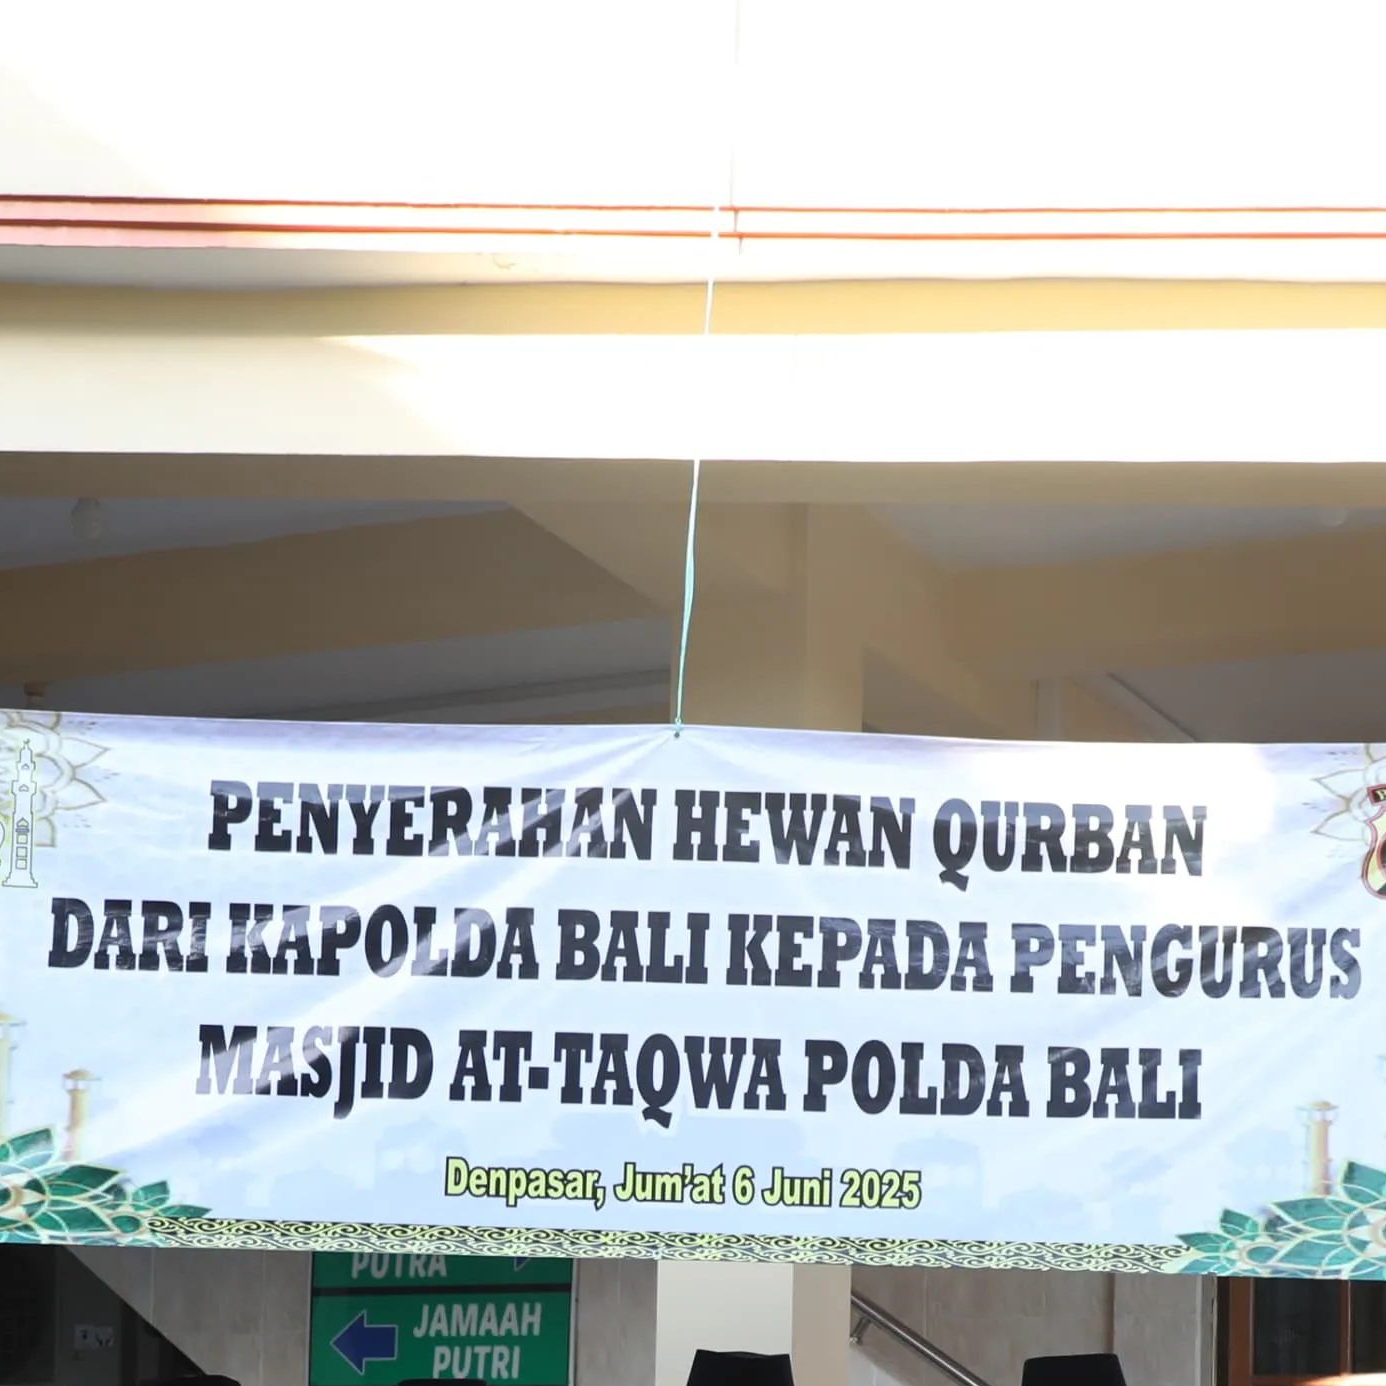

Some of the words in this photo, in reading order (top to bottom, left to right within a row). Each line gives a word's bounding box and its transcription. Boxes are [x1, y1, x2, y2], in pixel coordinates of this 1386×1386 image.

[208, 781, 657, 860] PENYERAHAN
[673, 790, 914, 869] HEWAN
[933, 800, 1207, 891] QURBAN
[48, 898, 211, 972] DARI
[226, 903, 539, 979] KAPOLDA
[556, 909, 709, 984] BALI
[726, 914, 993, 992] KEPADA
[1011, 924, 1359, 998] PENGURUS
[195, 1024, 433, 1118] MASJID
[449, 1030, 786, 1128] AT-TAQWA
[803, 1040, 1029, 1117] POLDA
[1047, 1047, 1201, 1119] BALI
[445, 1157, 606, 1211] Denpasar,
[613, 1162, 726, 1204] Jum'at
[732, 1165, 755, 1205] 6
[761, 1167, 832, 1207] Juni
[839, 1168, 922, 1209] 2025
[351, 1253, 448, 1280] PUTRA
[413, 1302, 543, 1338] JAMAAH
[432, 1345, 521, 1380] PUTRI
